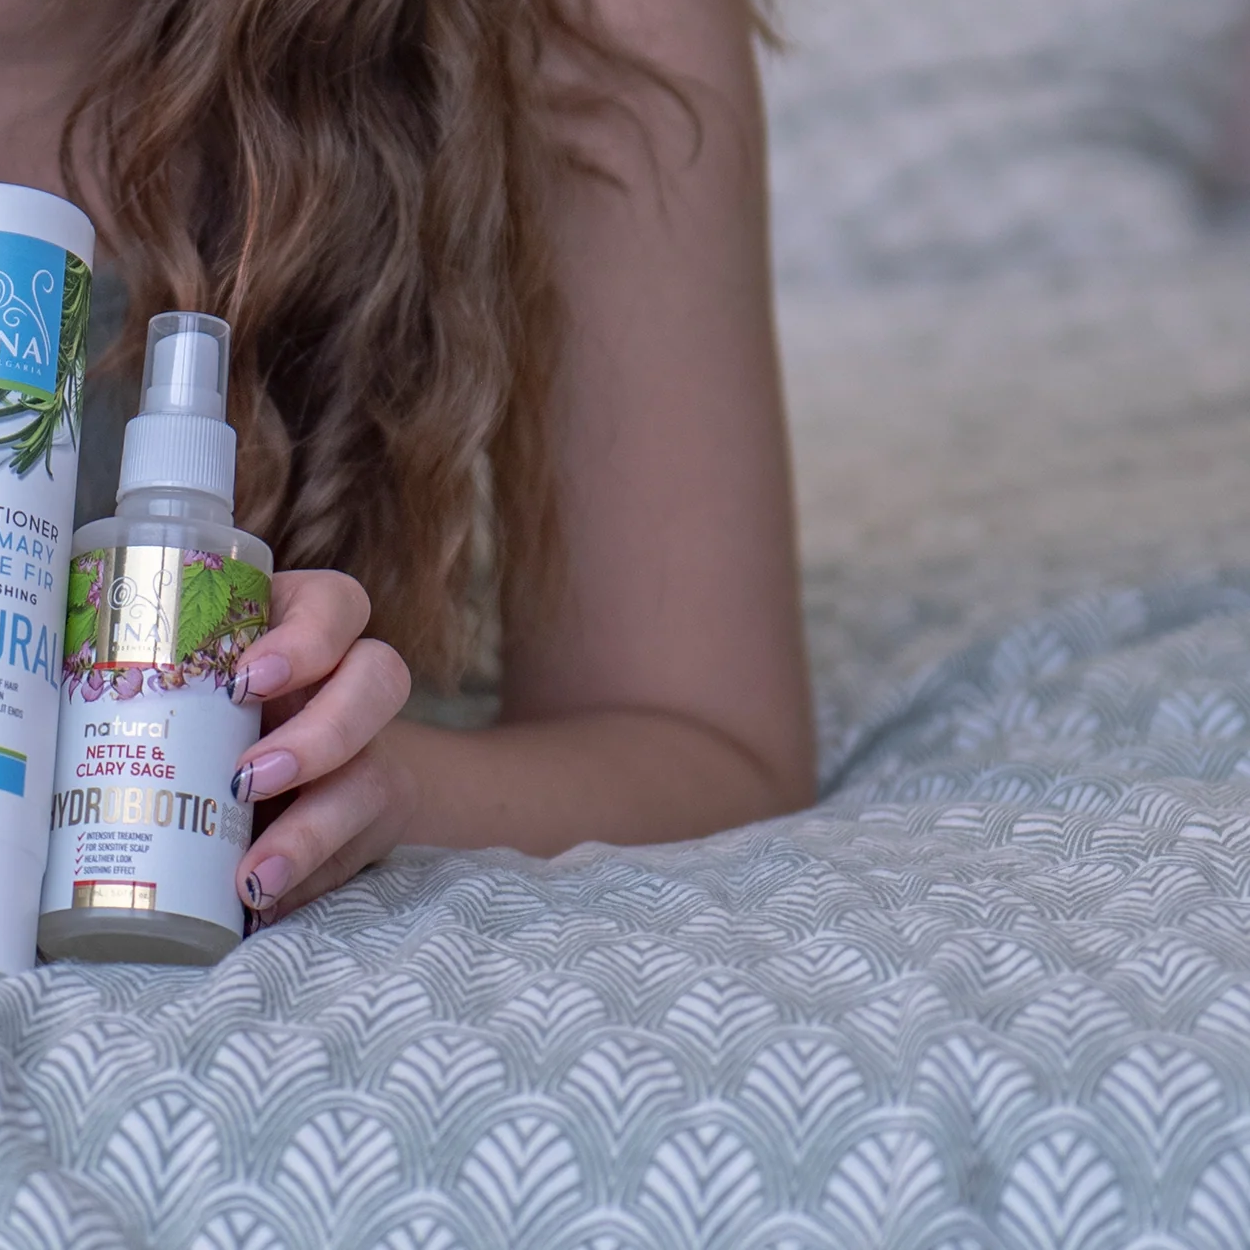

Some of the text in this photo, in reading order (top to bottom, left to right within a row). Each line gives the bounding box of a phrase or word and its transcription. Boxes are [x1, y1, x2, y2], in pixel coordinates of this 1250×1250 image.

[24, 563, 54, 592] FIR
[112, 622, 162, 643] INA
[4, 679, 19, 692] HAIR
[7, 705, 24, 719] ENDS
[84, 714, 170, 739] natural
[86, 744, 165, 761] NETTLE &
[76, 761, 176, 780] CLARY SAGE
[86, 831, 153, 842] INTENSIVE TREATMENT
[85, 842, 150, 853] FOR SENSITIVE SCALP
[84, 854, 133, 863] HEALTHIER LOOK
[83, 865, 136, 875] SOOTHING EFFECT
